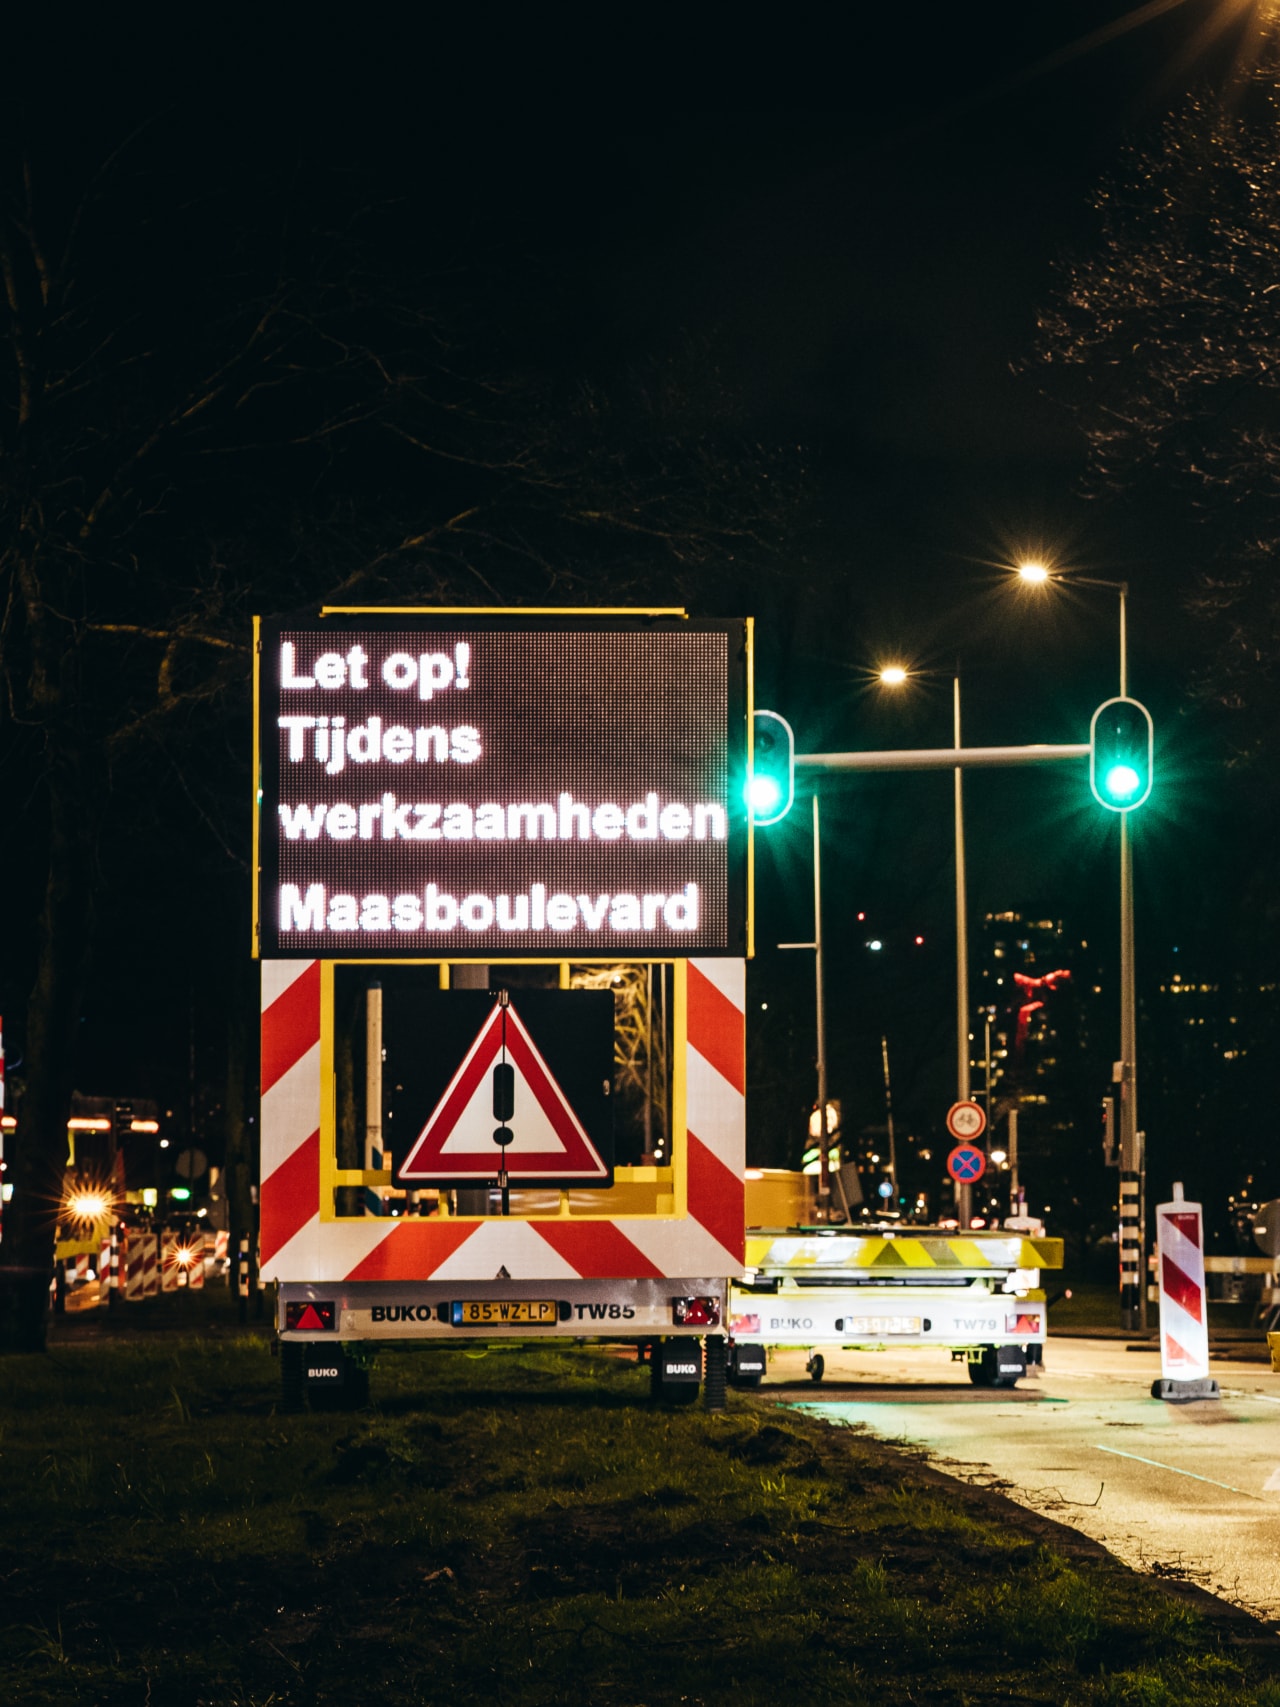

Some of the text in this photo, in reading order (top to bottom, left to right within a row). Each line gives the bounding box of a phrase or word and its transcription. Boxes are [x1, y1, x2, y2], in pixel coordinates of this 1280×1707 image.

[279, 641, 470, 701] Let op!
[278, 716, 481, 774] Tijdens
[278, 791, 728, 840] werkzaamheden
[279, 882, 699, 932] Maasboulevard
[469, 1303, 549, 1320] 85-WZ-LP
[574, 1303, 635, 1320] TW85
[953, 1319, 997, 1330] TW79
